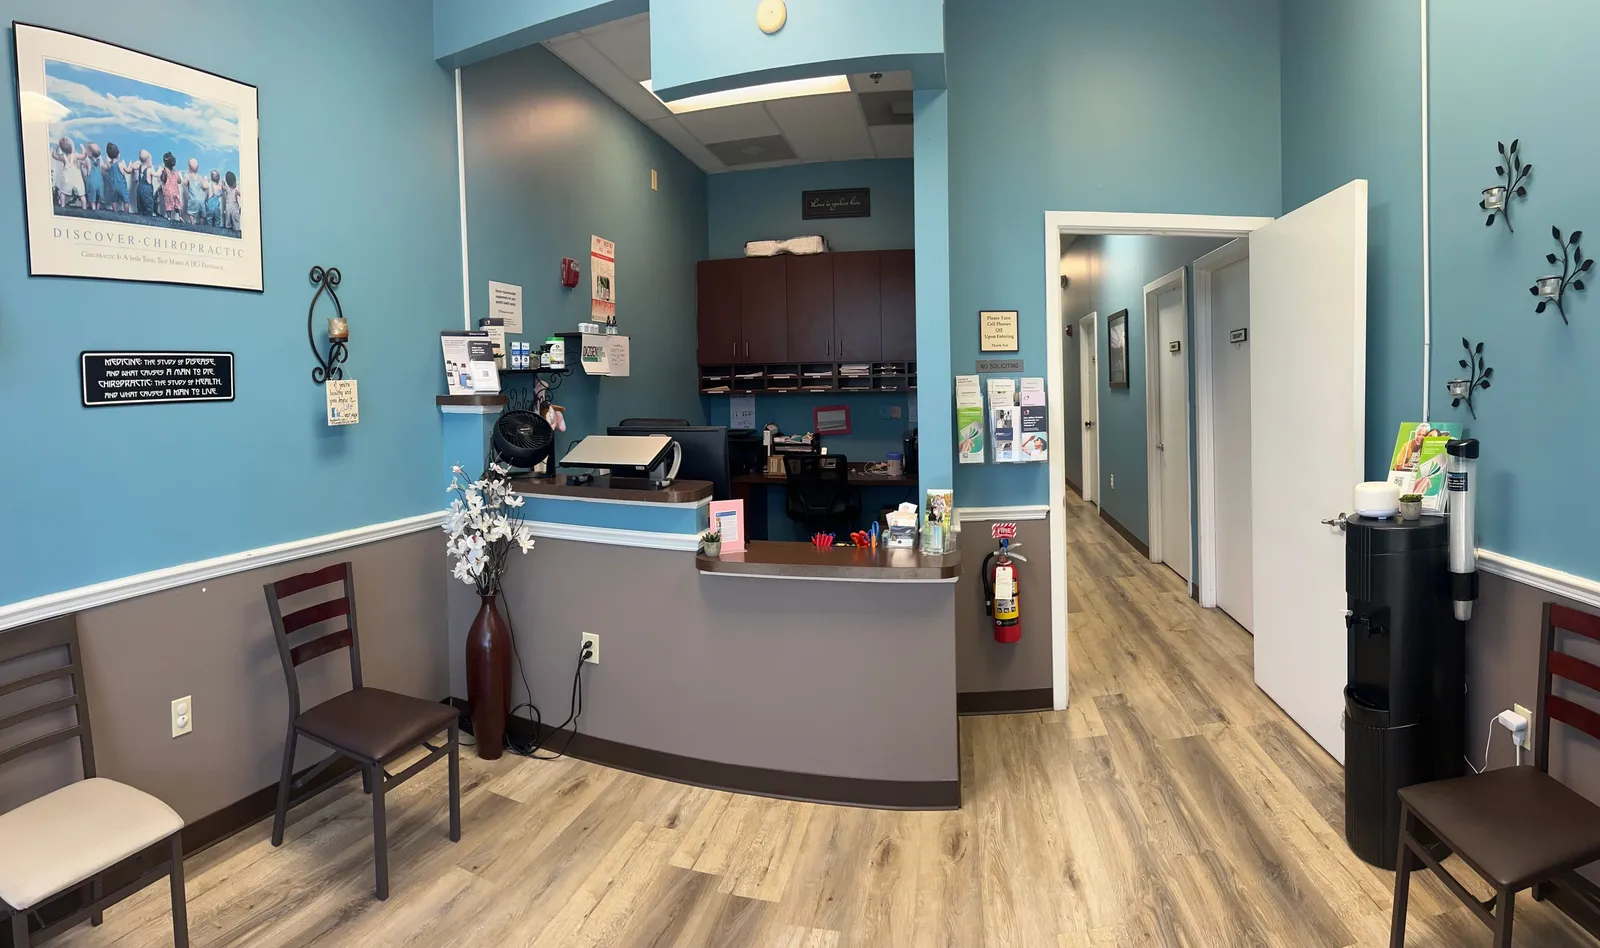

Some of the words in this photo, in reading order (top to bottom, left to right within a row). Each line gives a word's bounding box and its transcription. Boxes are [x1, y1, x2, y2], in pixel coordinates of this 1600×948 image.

[810, 196, 824, 207] Love
[830, 197, 848, 210] spoken
[850, 196, 860, 206] here
